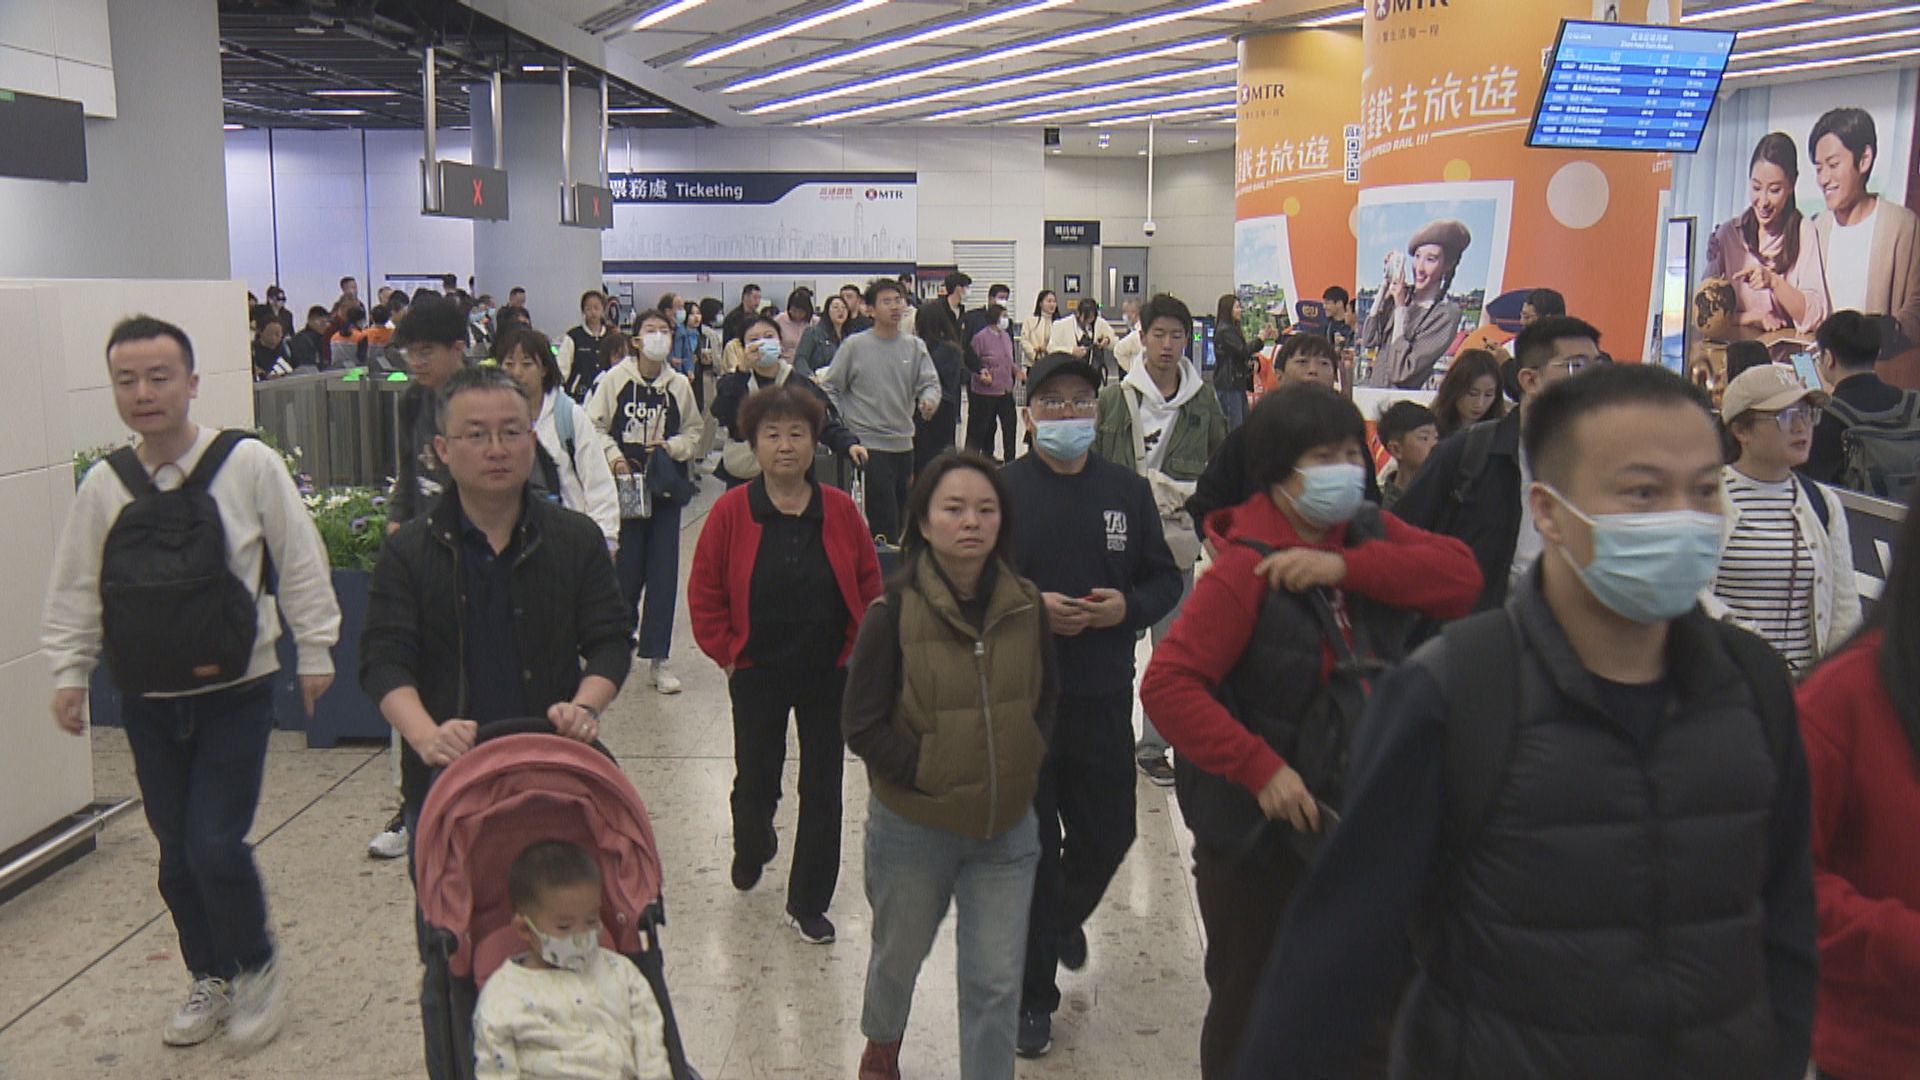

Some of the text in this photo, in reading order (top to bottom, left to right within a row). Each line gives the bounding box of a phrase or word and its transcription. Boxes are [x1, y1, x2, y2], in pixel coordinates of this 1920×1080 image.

[1252, 84, 1285, 100] MTR
[674, 181, 744, 201] Ticketing
[879, 190, 904, 200] MTR
